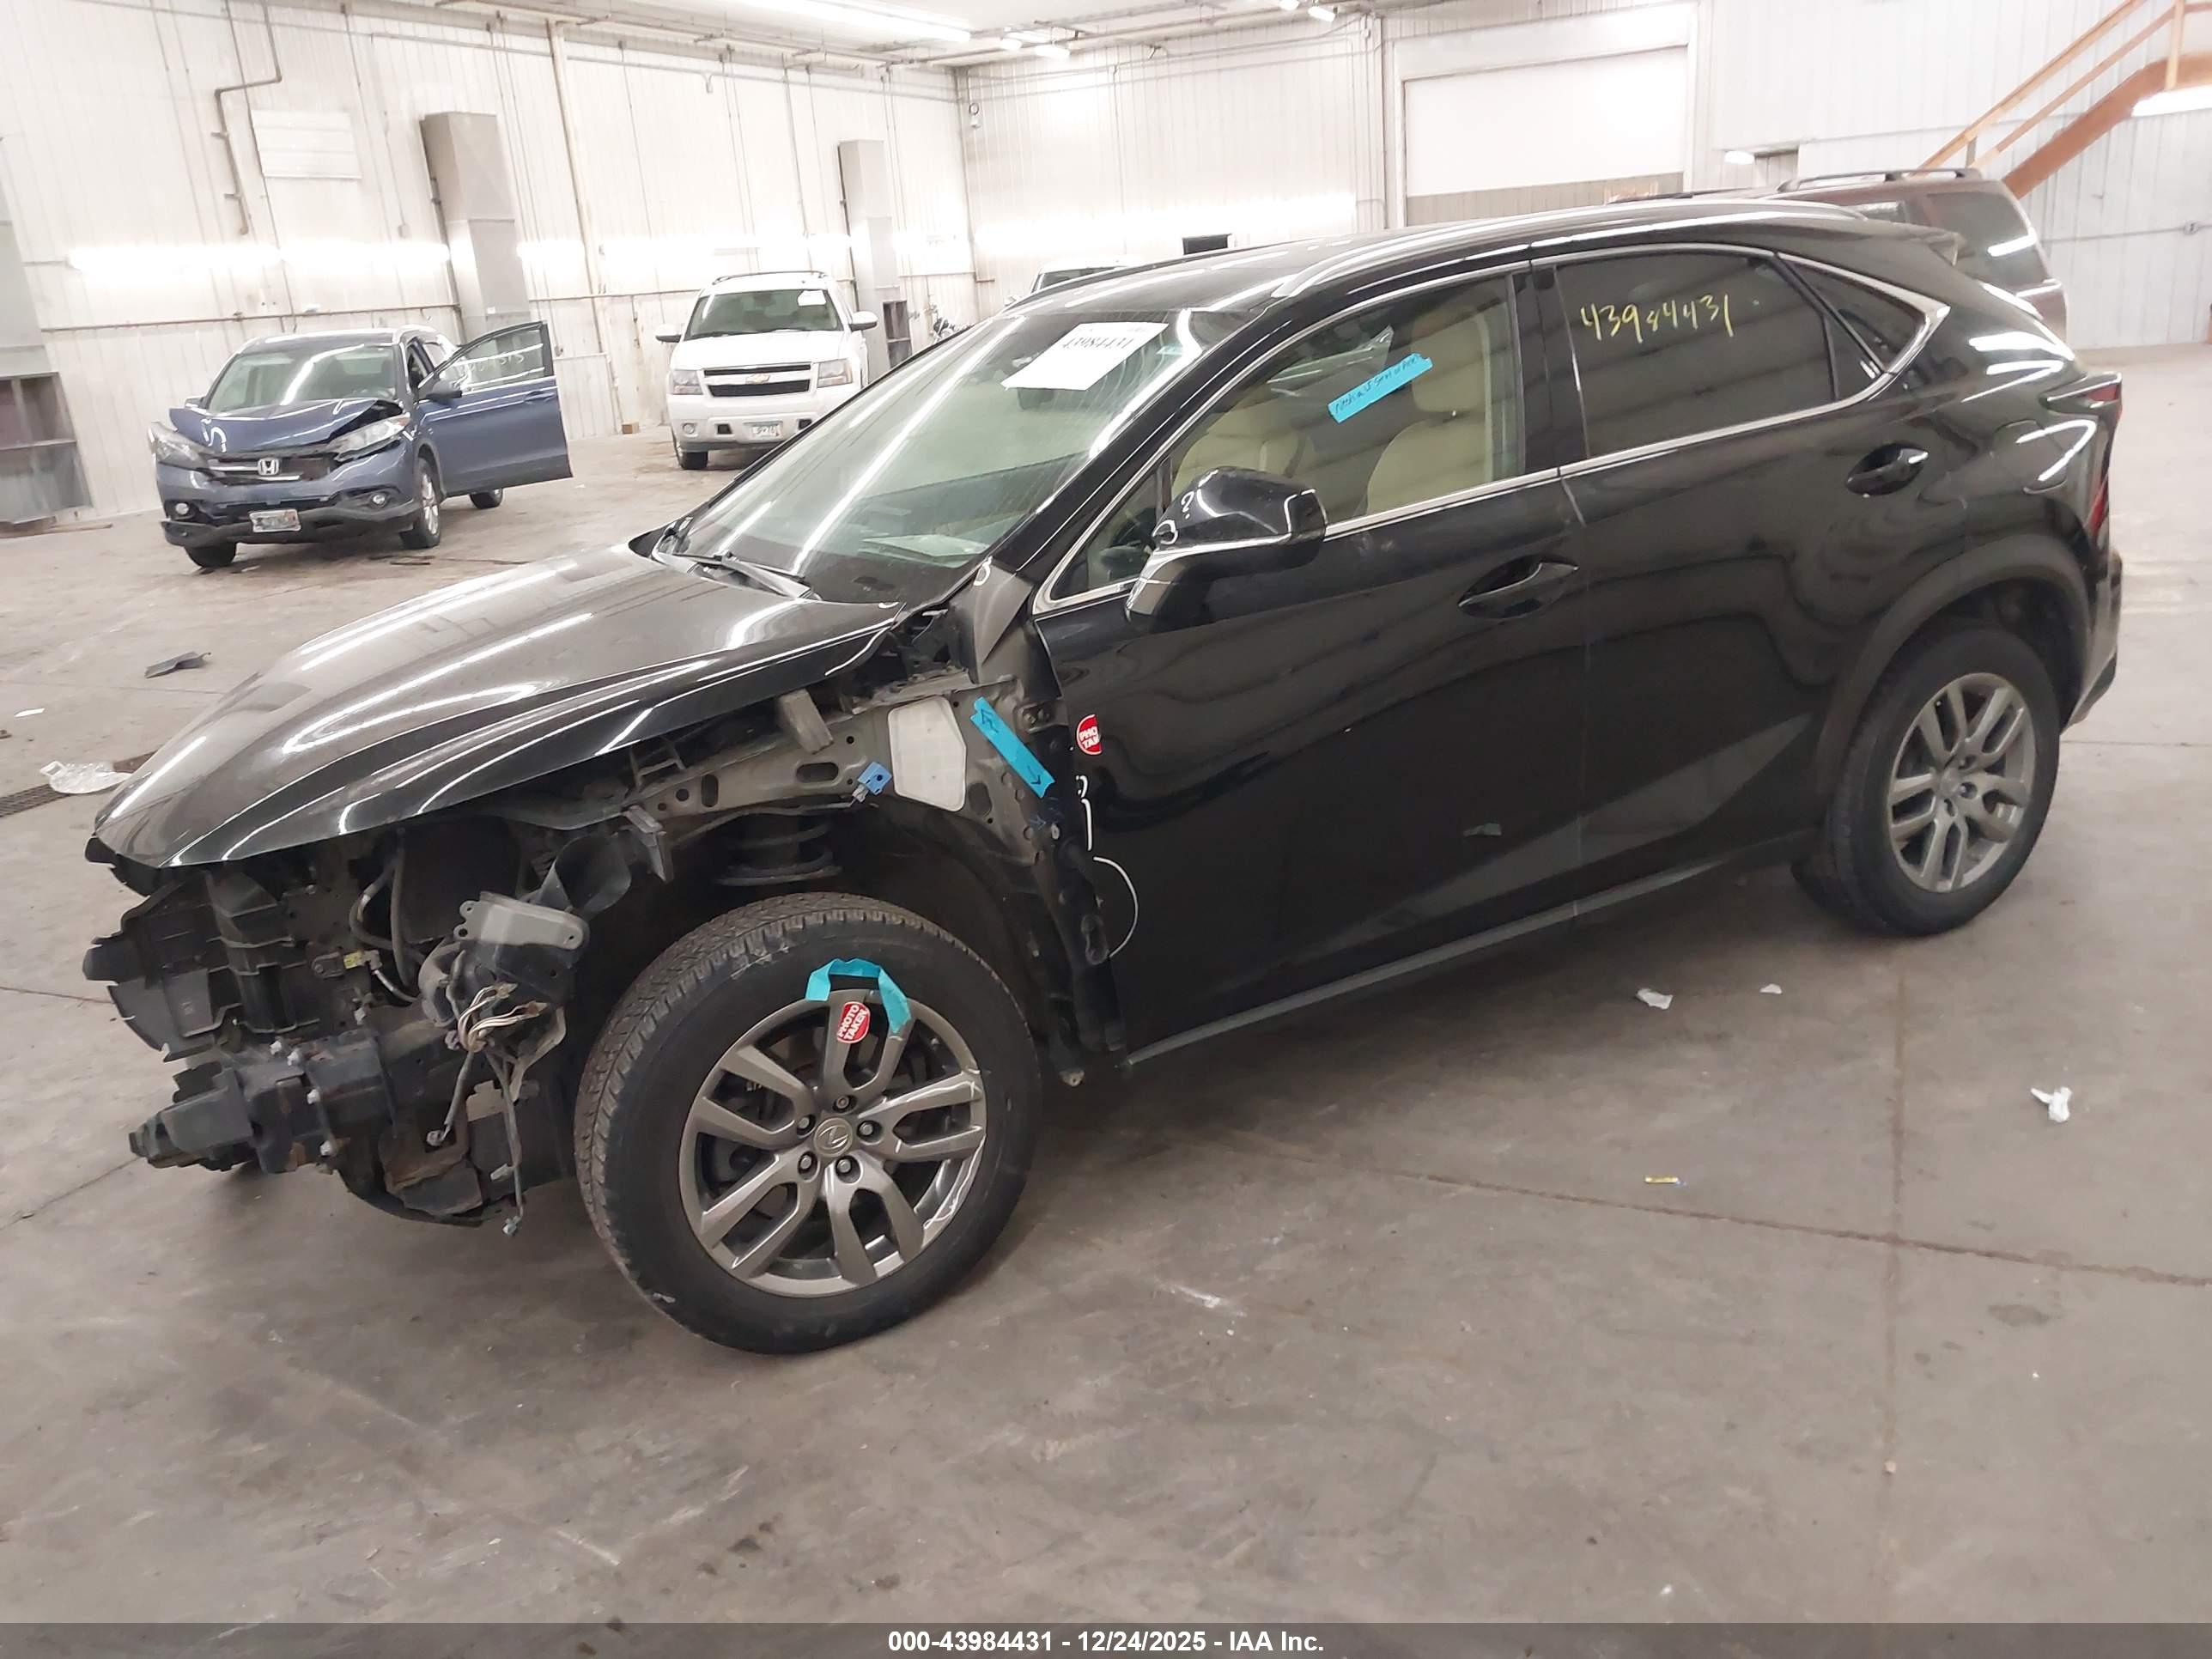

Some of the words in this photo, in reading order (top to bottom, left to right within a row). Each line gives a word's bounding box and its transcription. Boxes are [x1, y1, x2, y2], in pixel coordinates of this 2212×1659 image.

[1580, 293, 1734, 344] 43984431
[837, 1005, 860, 1037] PHOTO
[844, 1009, 867, 1040] TAKEN
